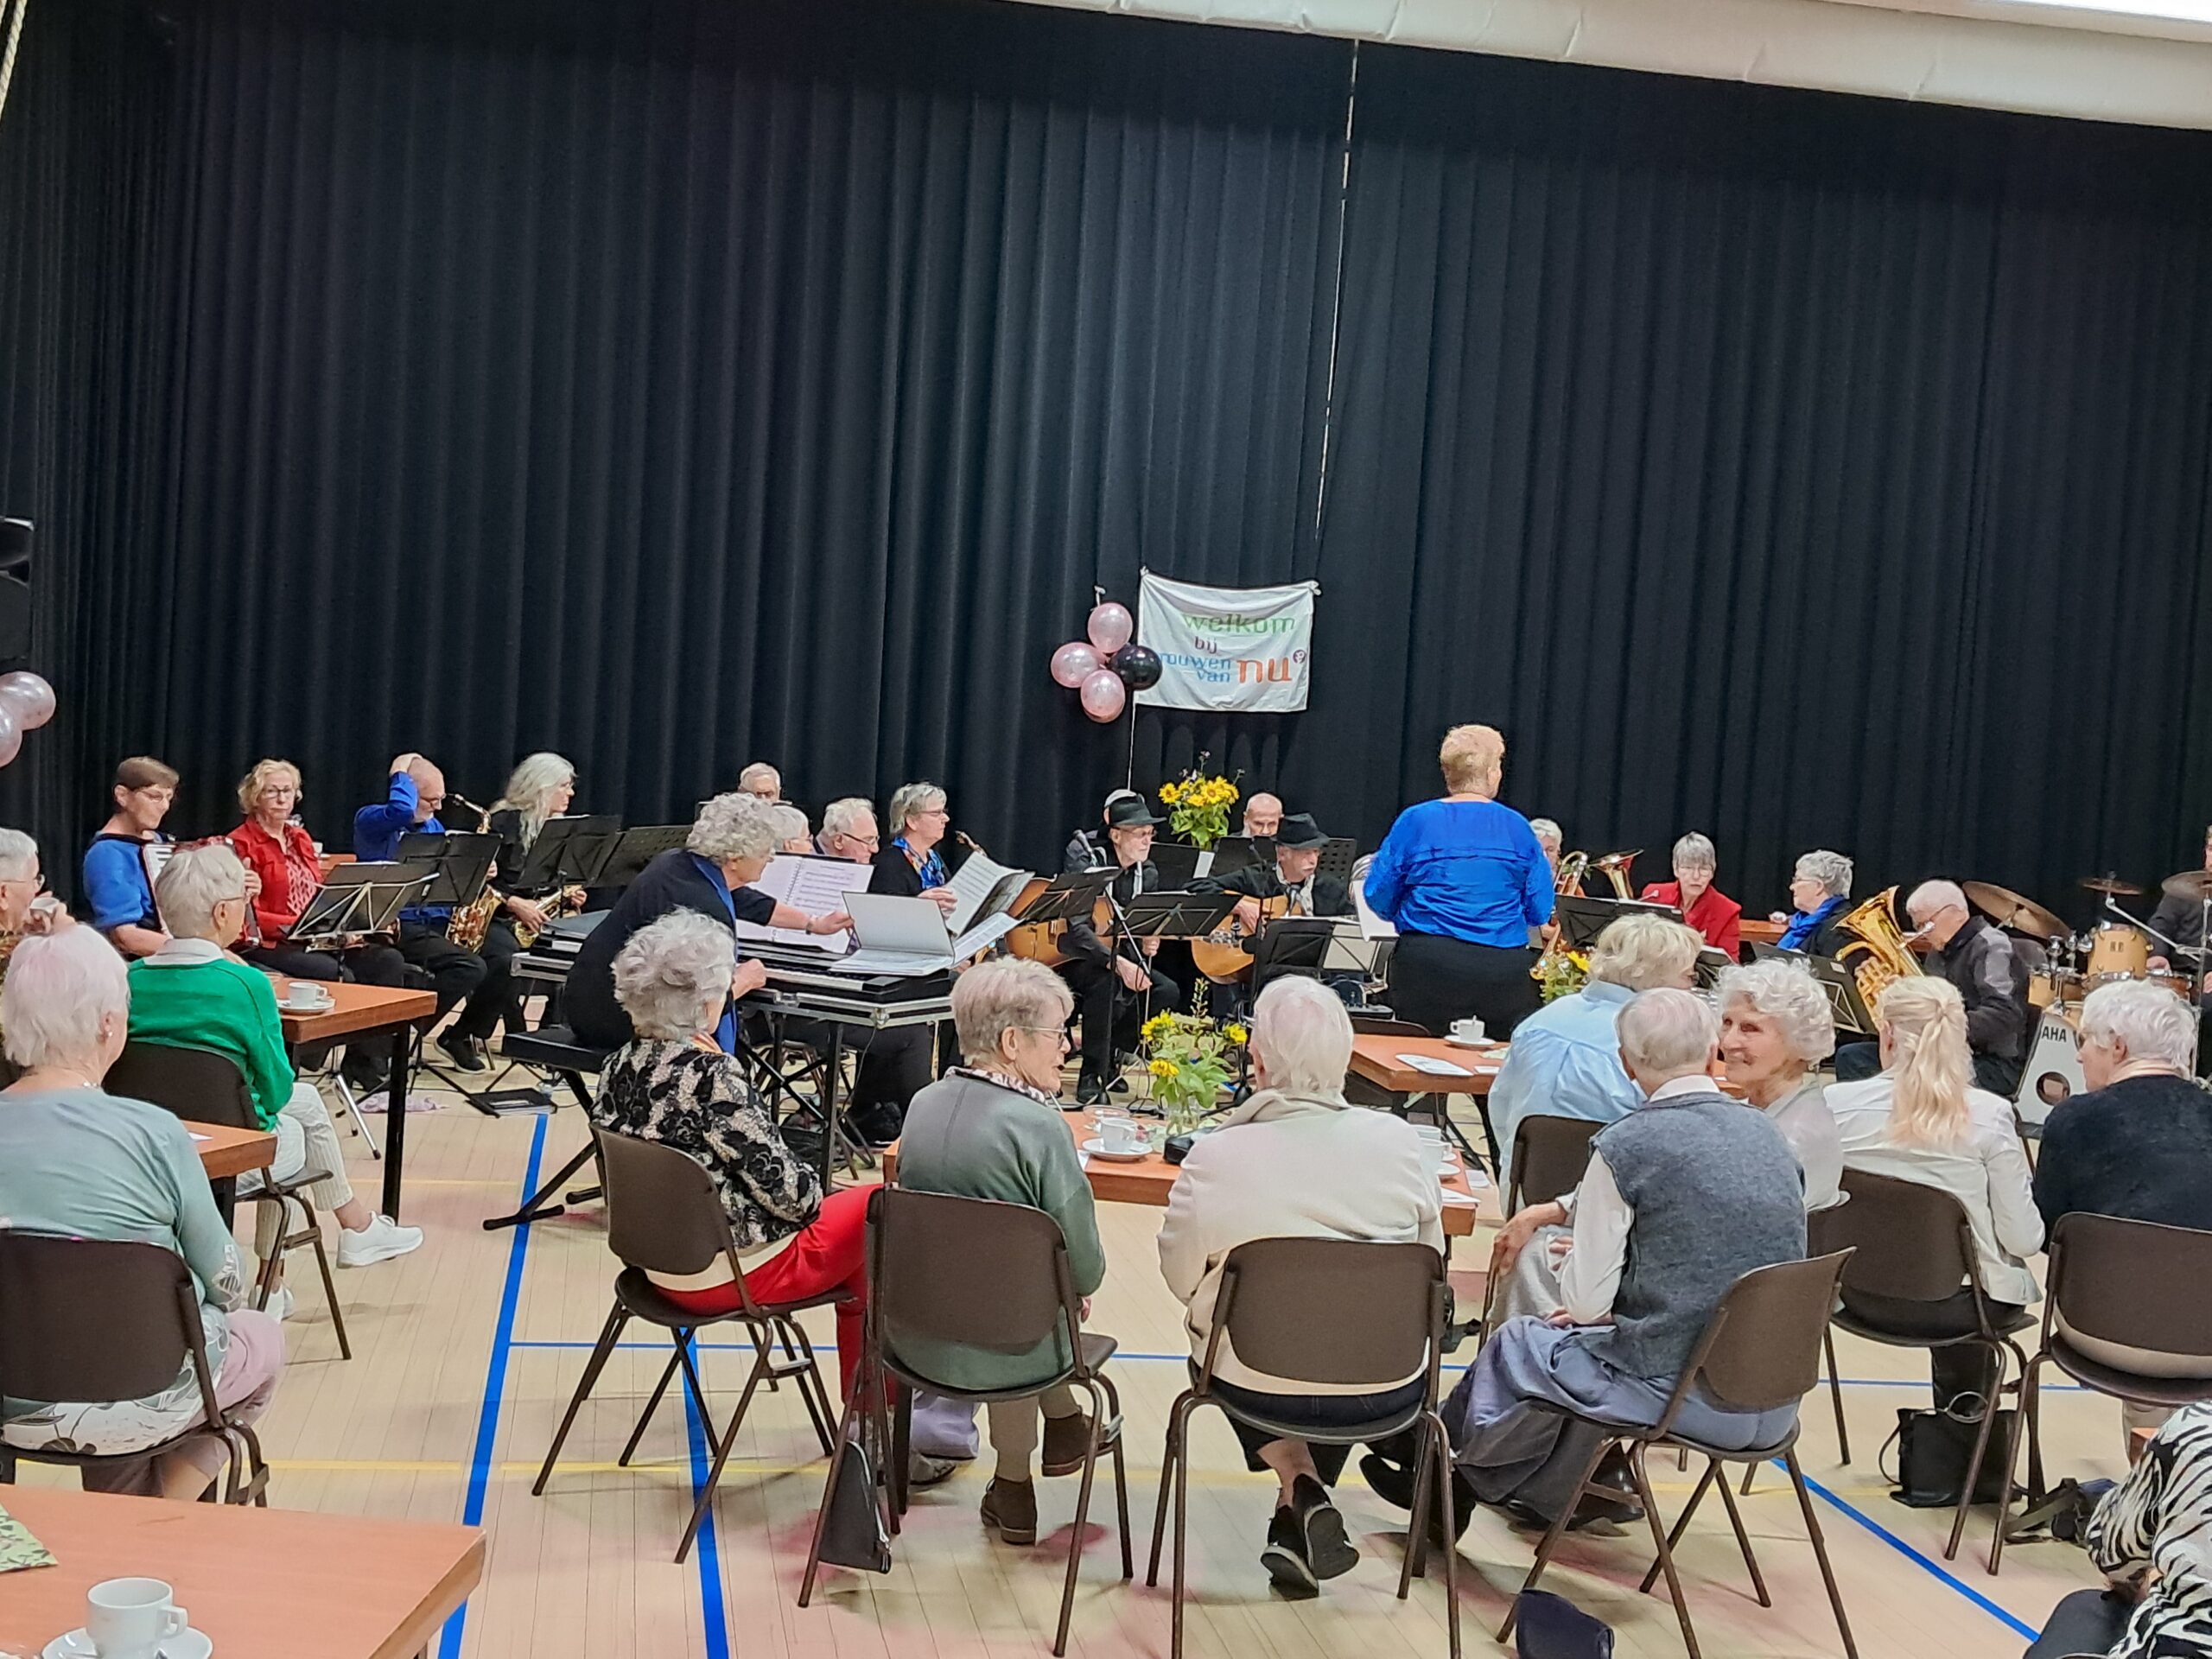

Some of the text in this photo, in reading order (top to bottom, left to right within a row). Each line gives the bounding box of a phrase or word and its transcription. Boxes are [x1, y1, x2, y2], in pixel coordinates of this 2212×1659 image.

[1183, 613, 1295, 633] welkom
[1194, 635, 1217, 654] bij
[1160, 652, 1230, 670] rouwen
[1236, 657, 1293, 683] nu
[1197, 669, 1230, 683] van
[2041, 1026, 2067, 1043] AHA
